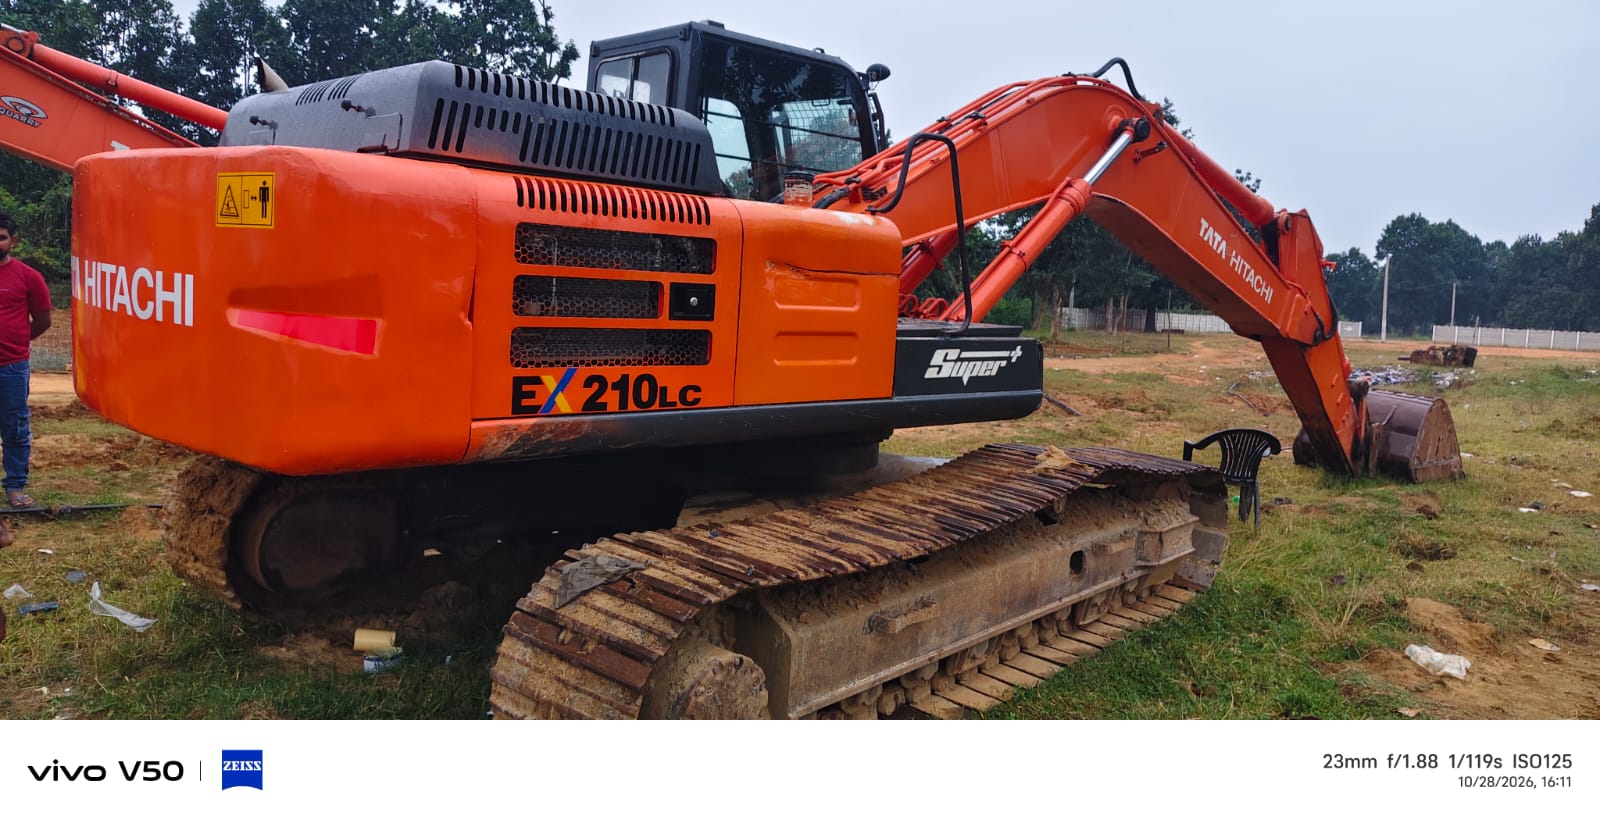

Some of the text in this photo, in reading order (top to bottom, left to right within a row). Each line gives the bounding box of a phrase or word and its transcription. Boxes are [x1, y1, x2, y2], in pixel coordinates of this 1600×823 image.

[84, 259, 194, 327] HITACHI
[1199, 217, 1274, 304] TATA HITACHI
